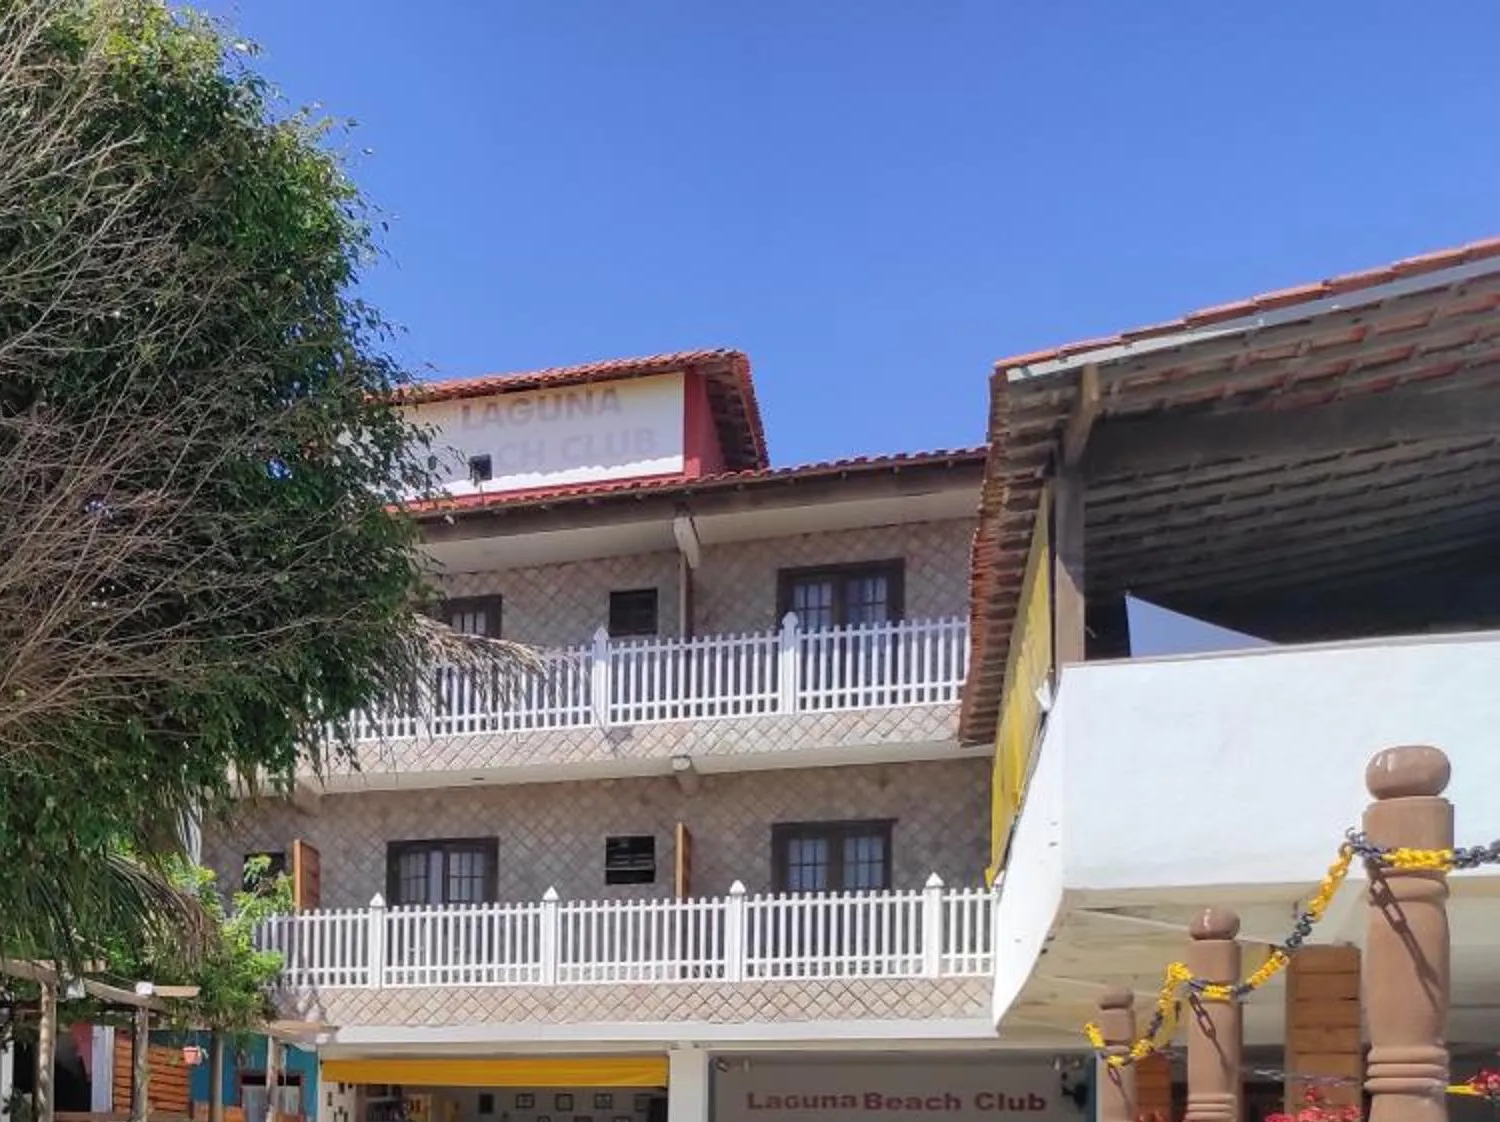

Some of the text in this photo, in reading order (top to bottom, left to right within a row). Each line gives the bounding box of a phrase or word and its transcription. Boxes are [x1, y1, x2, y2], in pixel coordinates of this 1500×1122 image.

[461, 385, 623, 430] LAGUNA
[562, 427, 660, 463] CLUB
[862, 1091, 963, 1112] Beach
[973, 1091, 1048, 1112] Club
